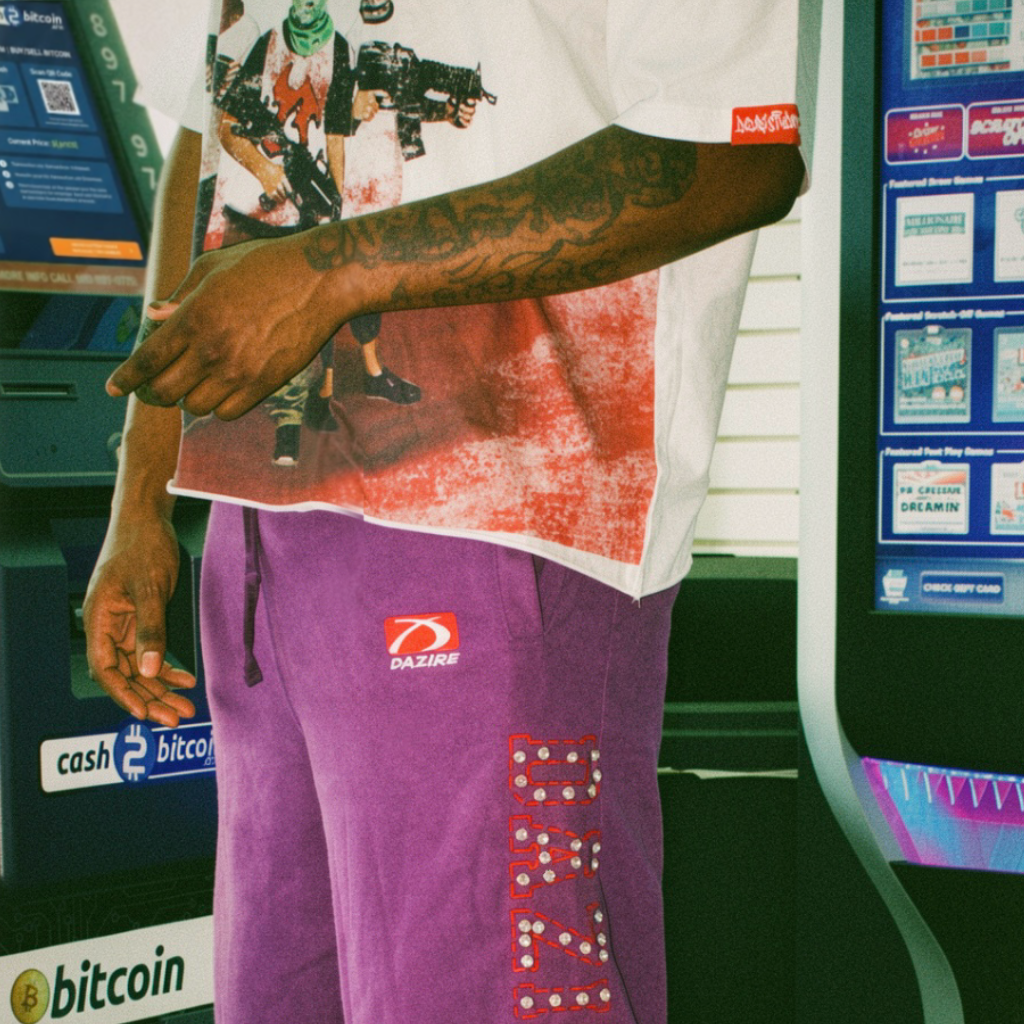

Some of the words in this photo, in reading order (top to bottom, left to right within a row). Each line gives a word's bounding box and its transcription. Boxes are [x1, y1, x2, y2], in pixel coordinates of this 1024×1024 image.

[23, 10, 62, 24] bitcoin
[390, 652, 461, 671] DAZIRE
[57, 741, 111, 776] cash
[157, 733, 214, 763] bitcoi
[50, 944, 185, 1019] bitcoin
